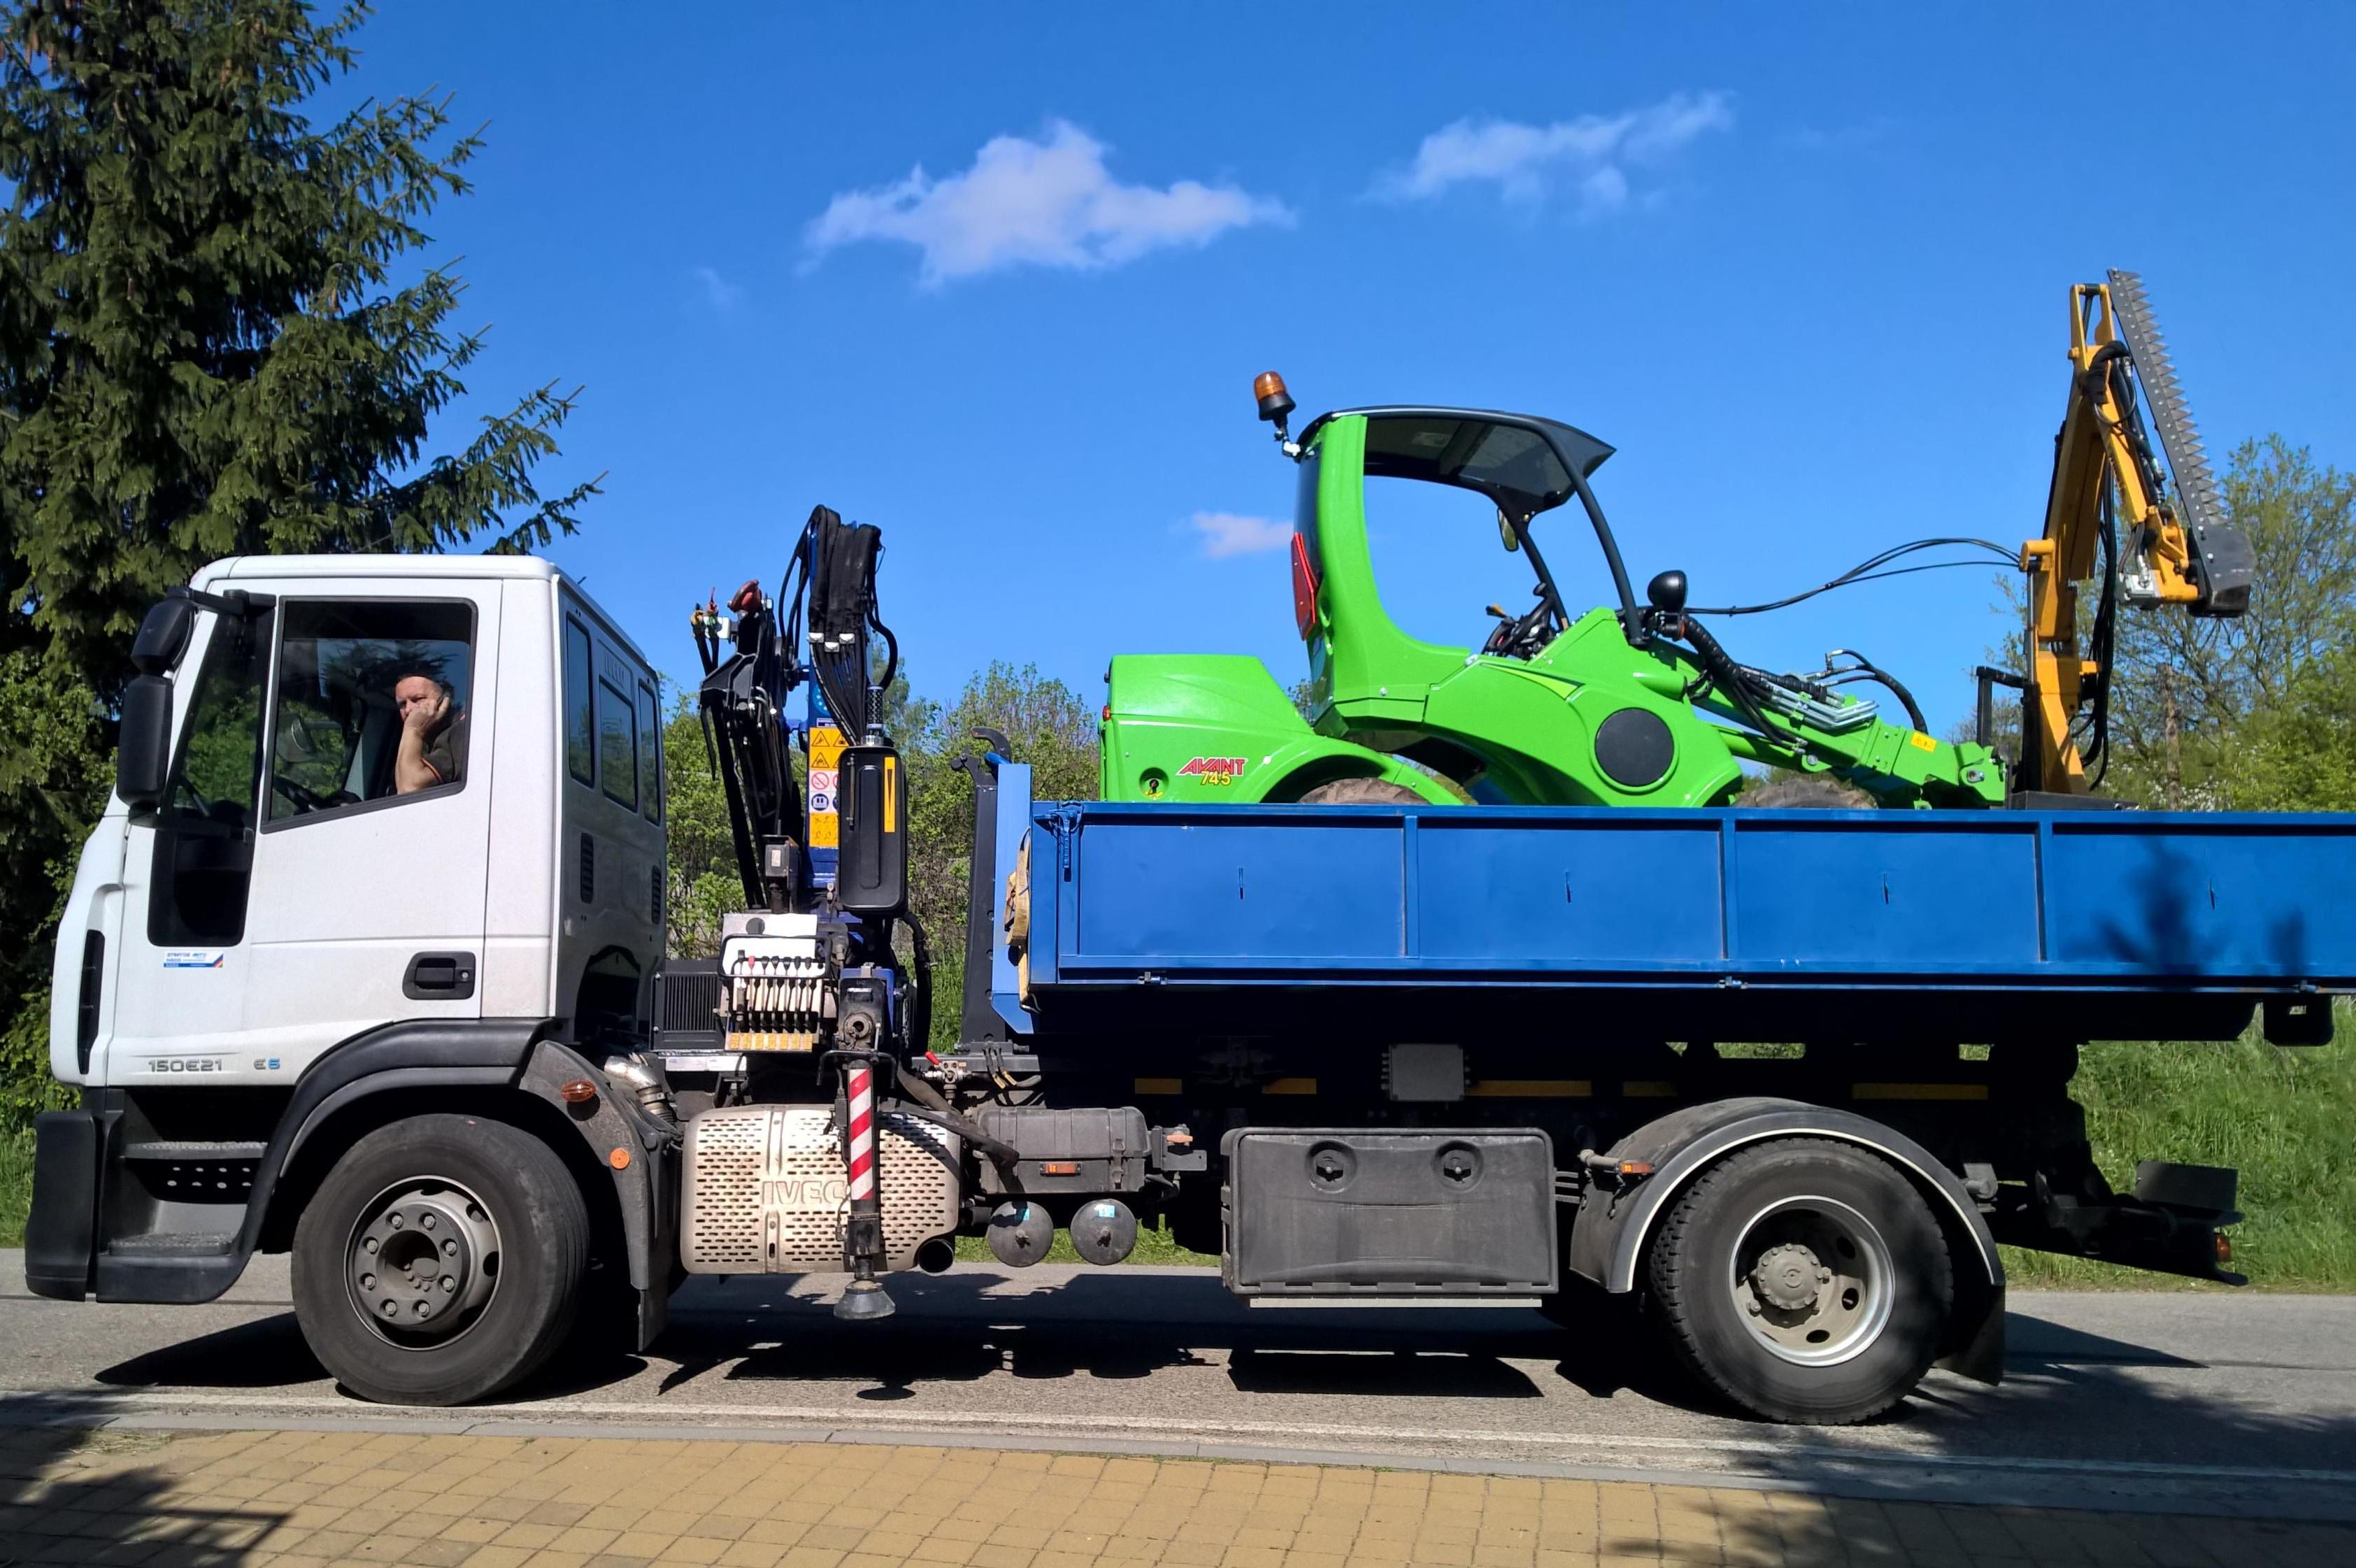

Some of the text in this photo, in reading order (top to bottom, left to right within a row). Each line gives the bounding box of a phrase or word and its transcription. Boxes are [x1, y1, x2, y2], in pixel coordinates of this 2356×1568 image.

[1177, 757, 1248, 776] AVANT
[1200, 769, 1231, 786] 745
[148, 1058, 222, 1072] 150E21
